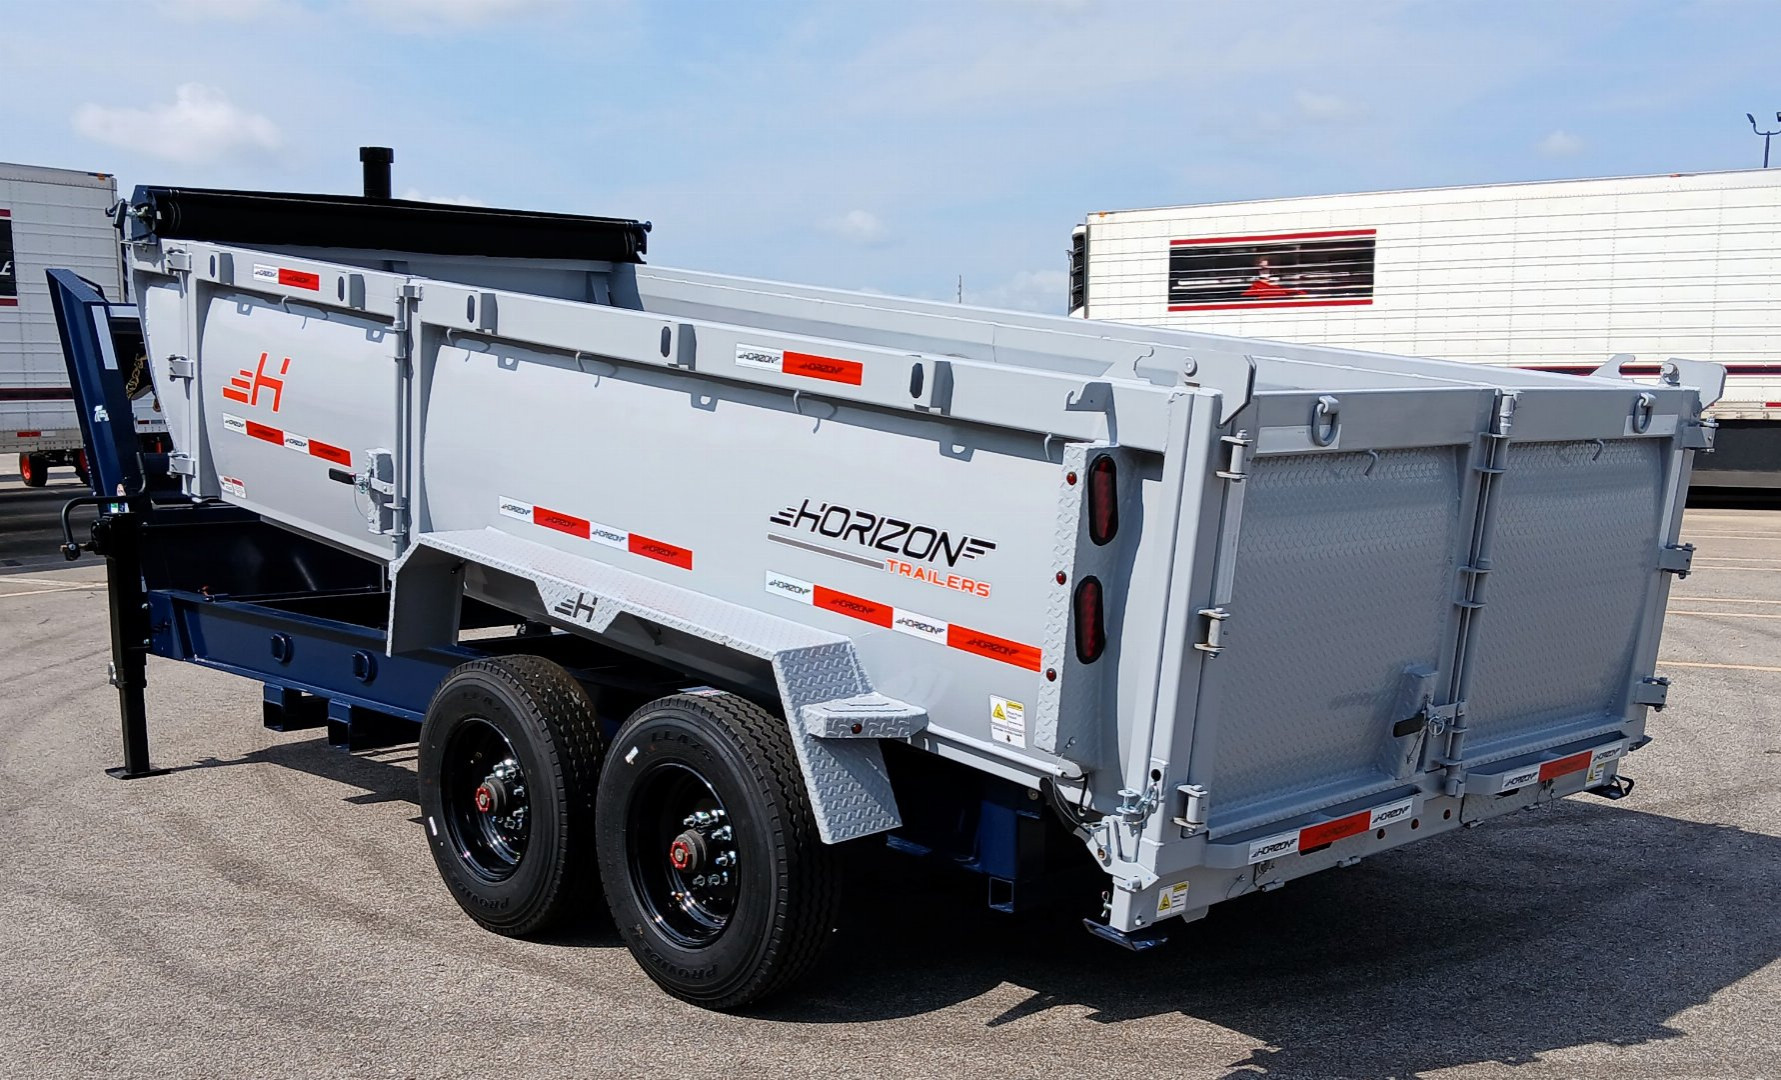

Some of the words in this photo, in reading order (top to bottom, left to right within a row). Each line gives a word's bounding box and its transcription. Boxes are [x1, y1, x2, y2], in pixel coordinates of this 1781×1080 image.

[742, 352, 776, 364] HORIZON
[793, 499, 968, 567] HORIZON
[886, 559, 991, 597] TRAILERS
[773, 579, 806, 595] HORIZON
[836, 599, 870, 614] HORIZON
[902, 617, 939, 635] HORIZON
[973, 639, 1013, 656] HORIZON
[1257, 839, 1292, 857] HORIZON
